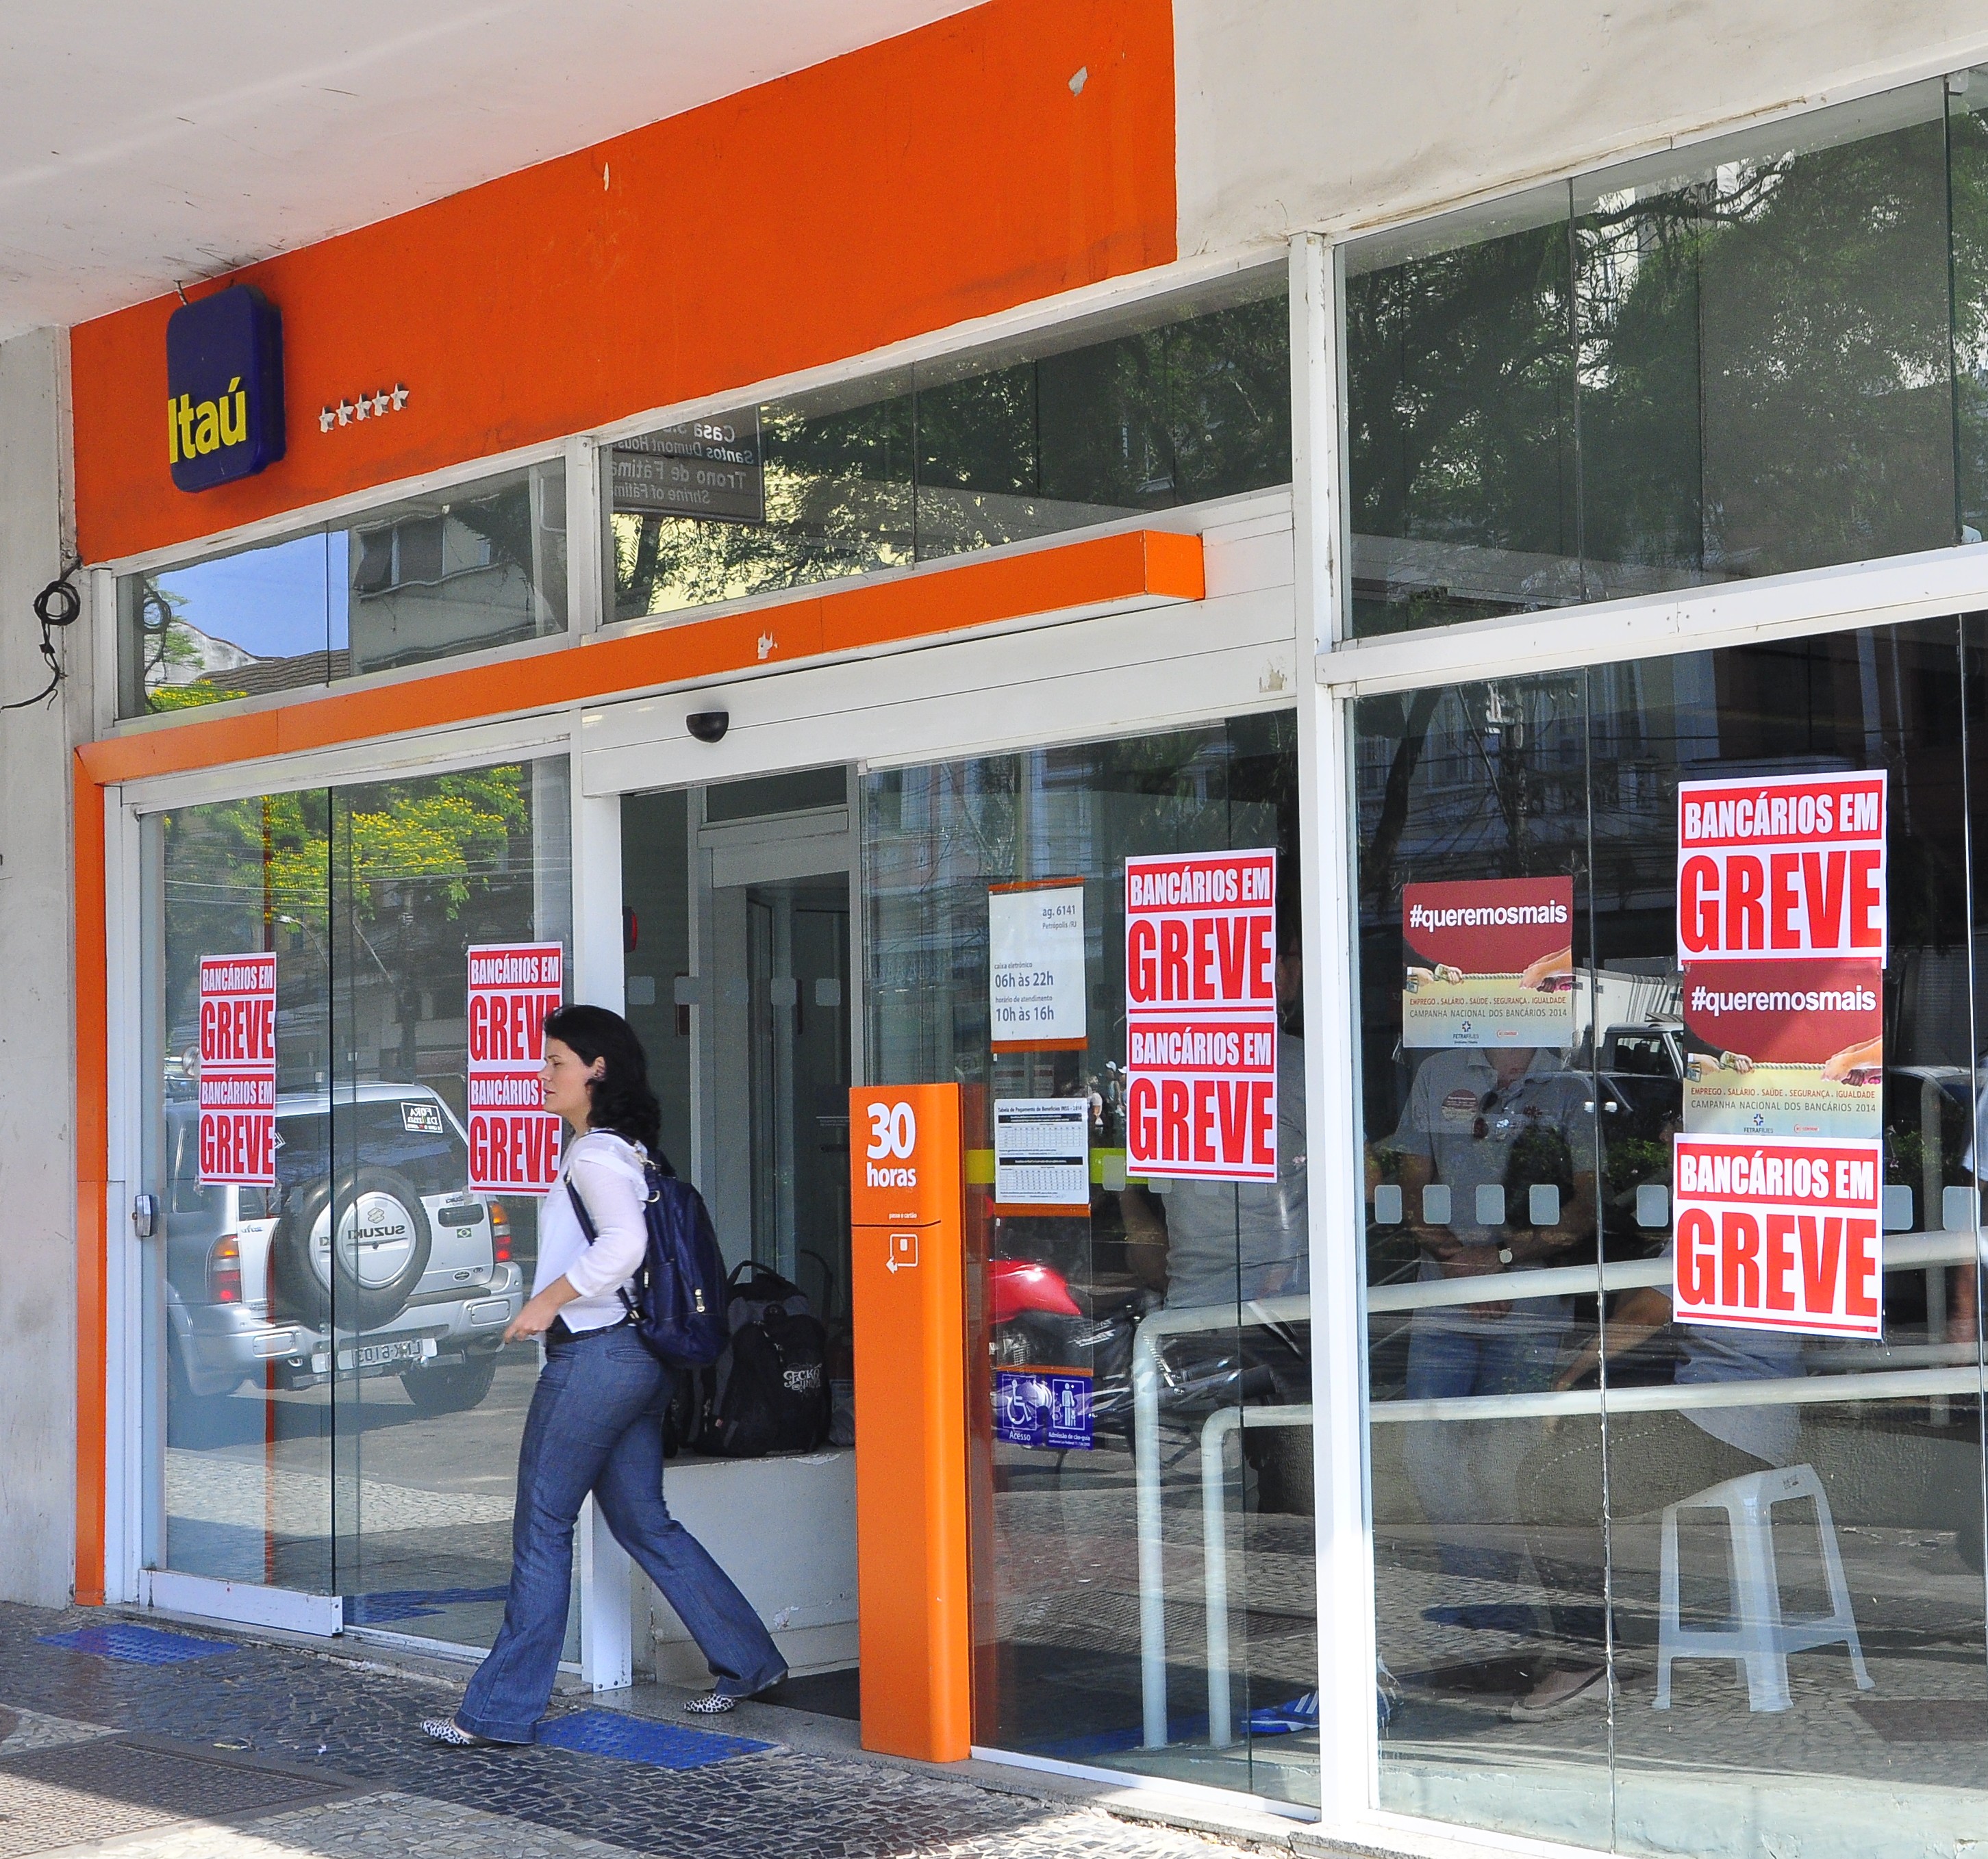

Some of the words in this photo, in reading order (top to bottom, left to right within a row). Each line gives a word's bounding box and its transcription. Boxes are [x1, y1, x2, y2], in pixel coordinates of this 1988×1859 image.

[168, 377, 247, 464] Itaú
[1685, 791, 1833, 839] BANCÁRIOS
[1839, 792, 1878, 832] EM
[1131, 865, 1237, 907] BANCÁRIOS
[1242, 867, 1270, 902] EM
[1680, 849, 1882, 952] GREVE
[1042, 908, 1055, 919] ag.
[1056, 905, 1075, 915] 6141
[1042, 922, 1068, 930] Petrópolis
[1410, 900, 1568, 933] #queremosmais
[471, 954, 539, 985] BANCÁRIOS
[541, 957, 559, 983] EM
[1129, 915, 1273, 1003] GREVE
[202, 963, 257, 991] BANCÁRIOS
[258, 966, 273, 989] EM
[995, 973, 1015, 987] 06h
[1018, 973, 1030, 986] às
[1033, 971, 1053, 986] 22h
[996, 1007, 1016, 1022] 10h
[1018, 1007, 1030, 1021] às
[1034, 1005, 1054, 1020] 16h
[1440, 997, 1465, 1005] SALÁRIO
[1470, 997, 1488, 1005] SAÚDE
[1532, 996, 1566, 1004] IGUALDADE
[1451, 1009, 1486, 1017] NACIONAL
[1506, 1008, 1546, 1017] BANCÁRIOS
[1549, 1009, 1567, 1017] 2014
[1691, 985, 1876, 1017] #queremosmais
[201, 1000, 273, 1061] GREVE
[470, 994, 560, 1061] GREV
[1132, 1028, 1240, 1065] BANCÁRIOS
[1244, 1032, 1271, 1066] EM
[201, 1078, 257, 1106] BANCÁRIOS
[258, 1081, 273, 1104] EM
[471, 1075, 539, 1106] BANCÁRIOS
[1691, 1087, 1722, 1096] EMPREGO
[1728, 1087, 1755, 1096] SALÁRIO
[1761, 1088, 1783, 1097] SAÚDE
[1789, 1089, 1830, 1099] SEGURANÇA
[1836, 1090, 1875, 1098] IGUALDADE
[1691, 1100, 1735, 1109] CAMPANHA
[1739, 1101, 1781, 1110] NACIONAL
[1784, 1102, 1800, 1111] DOS
[1804, 1101, 1852, 1111] BANCÁRIOS
[1856, 1103, 1876, 1112] 2014
[866, 1102, 916, 1159] 30
[1129, 1078, 1274, 1165] GREVE
[201, 1115, 273, 1174] GREVE
[470, 1116, 559, 1183] GREVE
[866, 1162, 916, 1187] horas
[1680, 1150, 1829, 1198] BANCÁRIOS
[1835, 1160, 1874, 1200] EM
[1677, 1208, 1877, 1317] GREVE
[1009, 1430, 1031, 1441] Acesso
